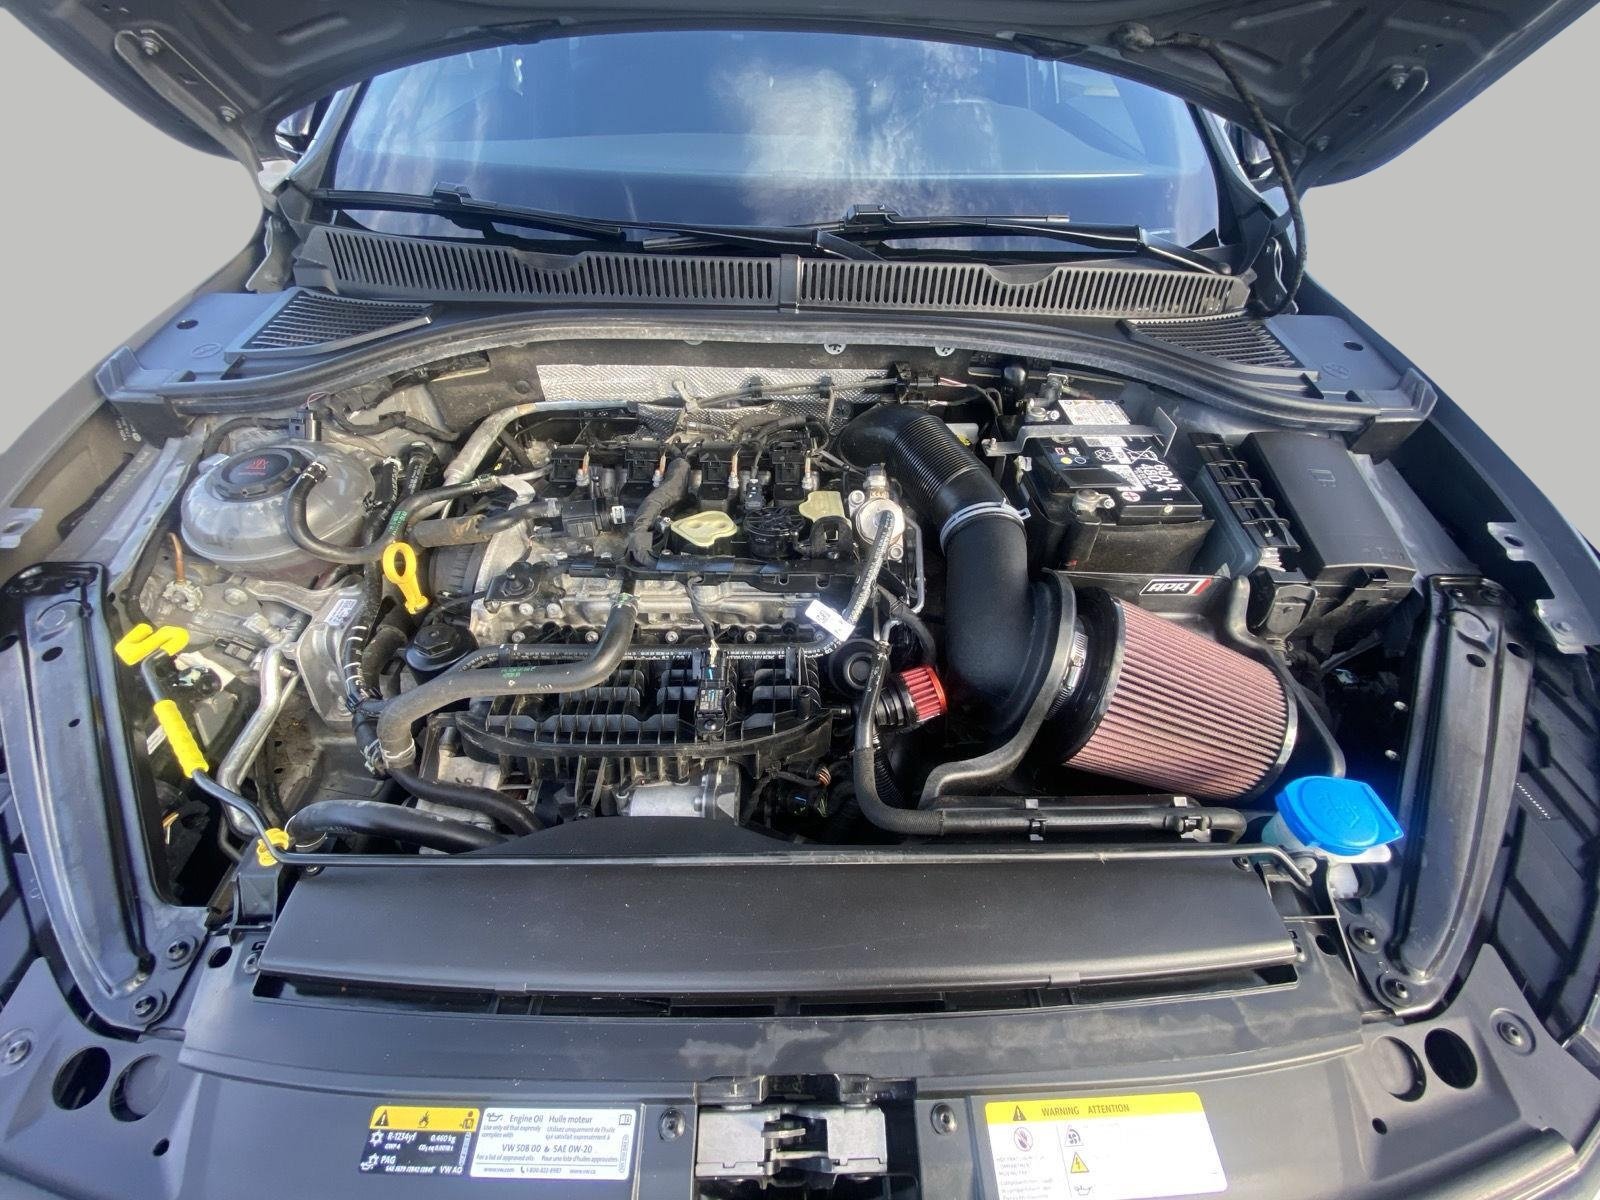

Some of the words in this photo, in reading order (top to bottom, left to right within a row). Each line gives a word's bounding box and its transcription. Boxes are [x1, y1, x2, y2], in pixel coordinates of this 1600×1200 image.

[1141, 464, 1162, 481] 480
[1147, 582, 1190, 591] APR
[1041, 1106, 1080, 1117] WARNING
[1087, 1104, 1130, 1115] ATTENTION
[510, 1114, 532, 1124] Engine
[534, 1114, 544, 1122] Oil
[549, 1115, 566, 1123] Huile
[568, 1116, 592, 1124] moteur
[387, 1132, 417, 1144] R-1234yf
[448, 1135, 456, 1144] kg
[553, 1144, 568, 1152] SAE
[568, 1145, 592, 1153] 0W-20
[381, 1156, 396, 1164] PAG
[440, 1166, 452, 1174] VW
[452, 1166, 462, 1174] AG
